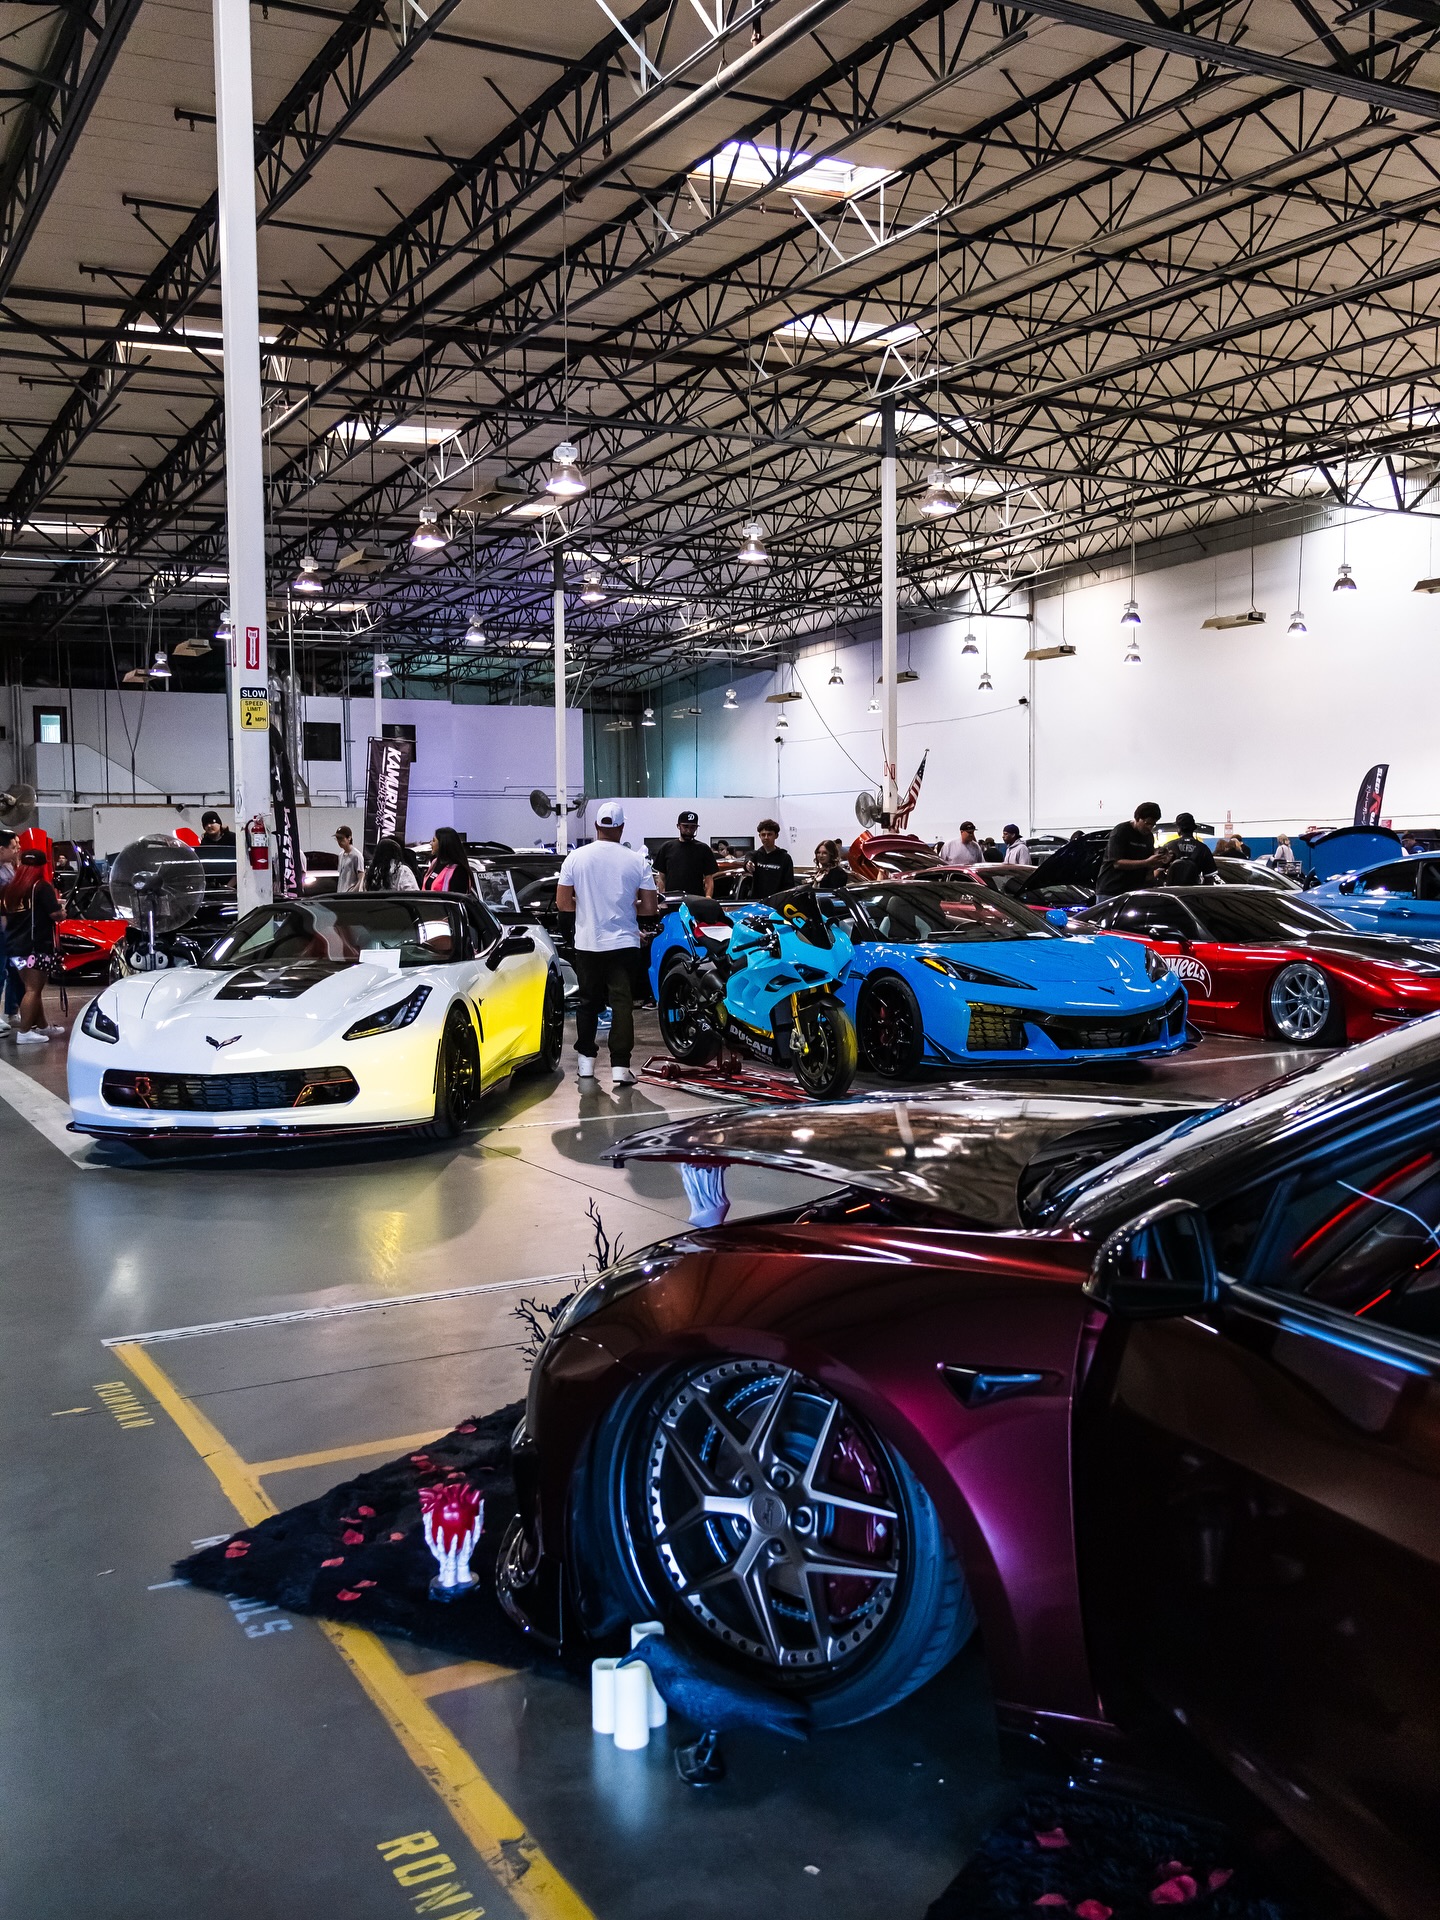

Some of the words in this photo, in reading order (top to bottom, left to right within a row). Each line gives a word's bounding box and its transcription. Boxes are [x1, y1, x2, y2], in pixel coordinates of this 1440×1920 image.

[242, 690, 266, 698] SLOW
[246, 712, 252, 725] 2
[385, 746, 402, 809] KAMURI
[729, 1024, 773, 1056] DUCATI
